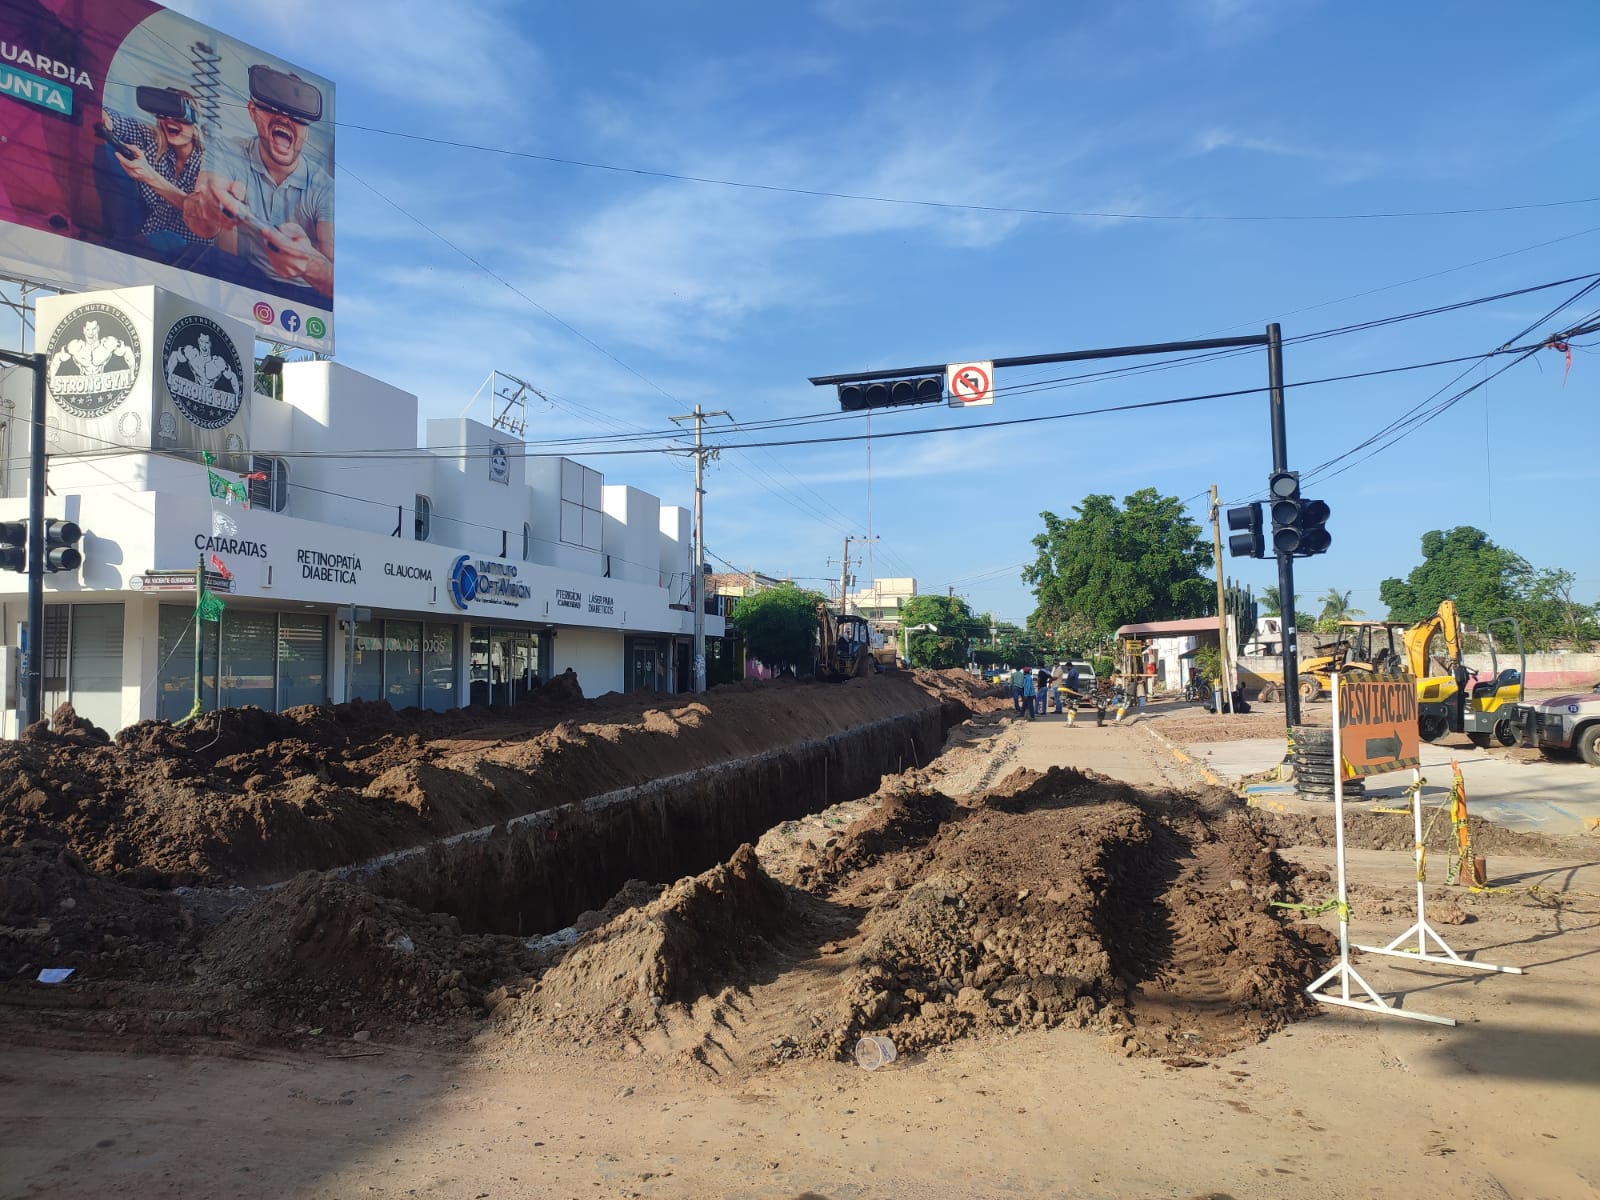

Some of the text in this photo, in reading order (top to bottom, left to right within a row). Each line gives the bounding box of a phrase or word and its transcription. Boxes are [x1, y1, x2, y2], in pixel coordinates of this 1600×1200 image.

[85, 304, 111, 312] NUTRE
[121, 316, 141, 348] CUERPO
[55, 372, 132, 394] STRONG GYM
[171, 376, 237, 411] STRONG GYM
[194, 533, 268, 559] CATARATAS
[297, 548, 362, 571] RETINOPATÍA
[475, 560, 518, 578] INSTITUTO
[302, 564, 357, 585] DIABETICA
[384, 562, 433, 582] GLAUCOMA
[424, 639, 446, 653] OJOS
[1340, 682, 1417, 728] DESVIACION
